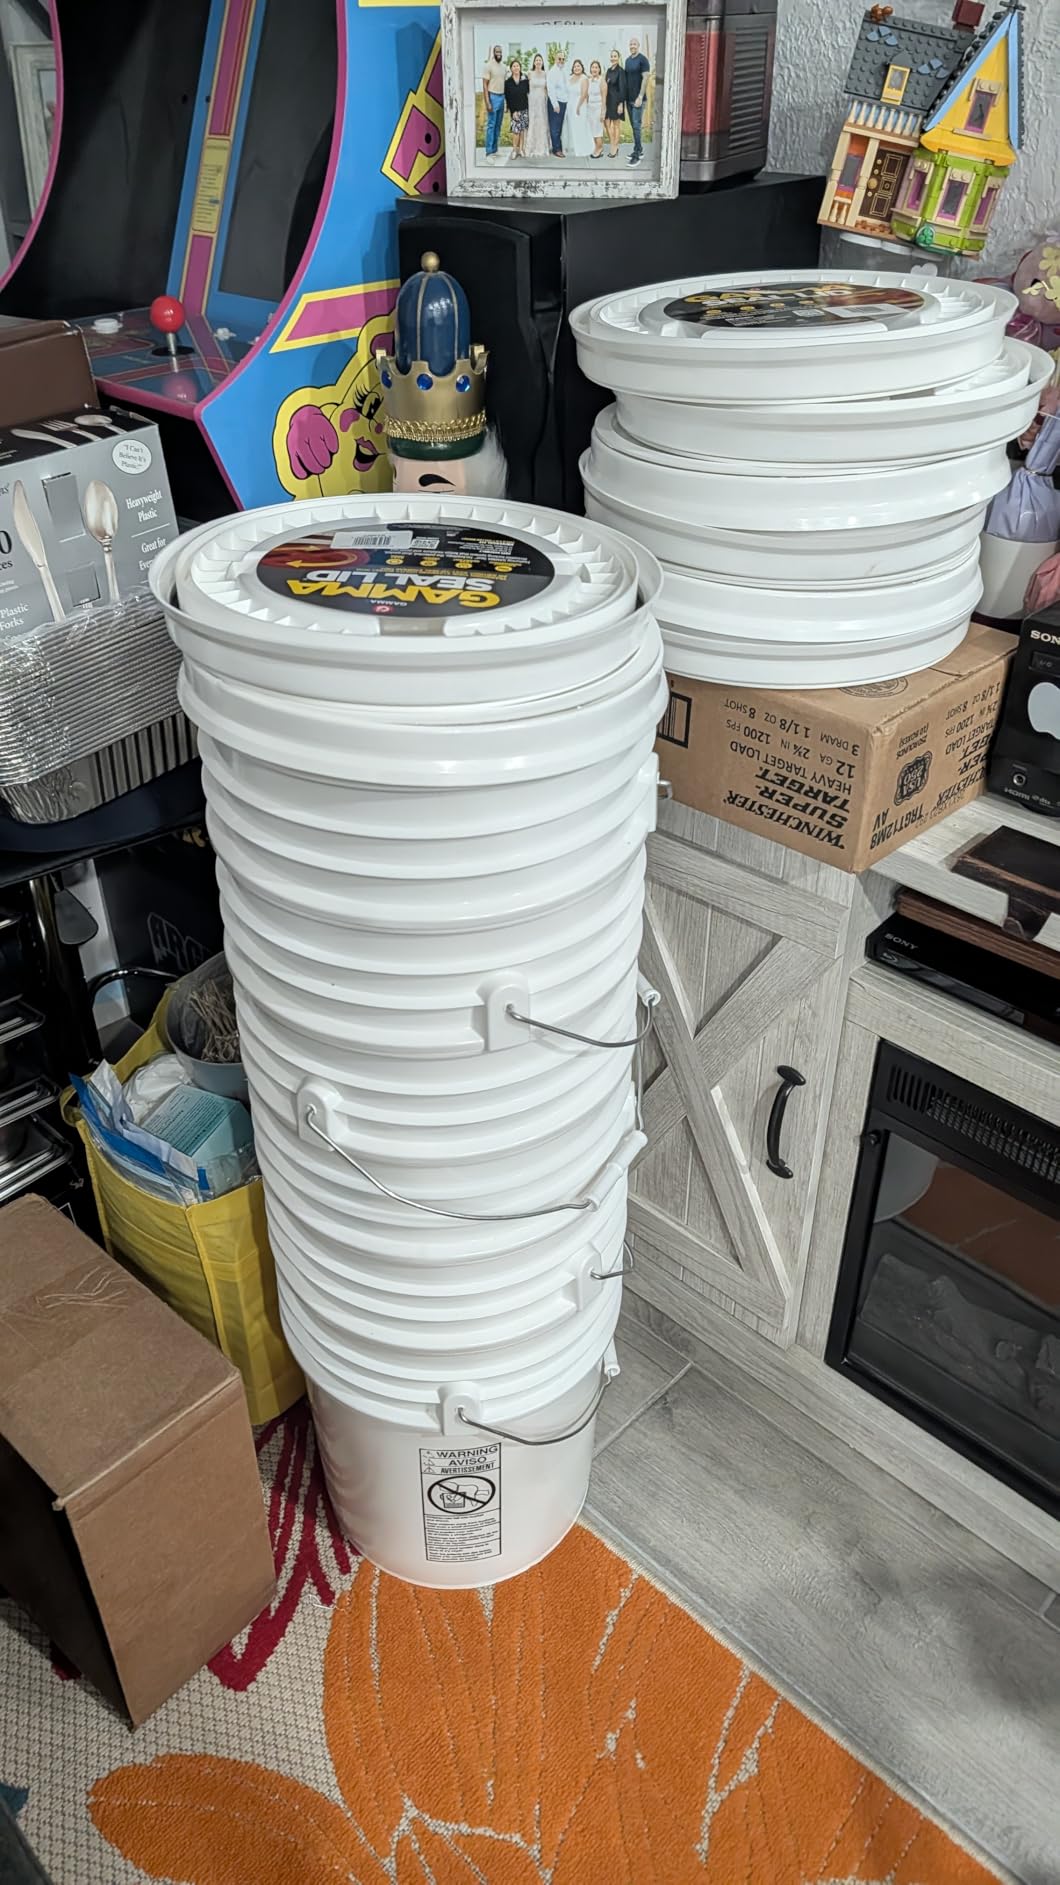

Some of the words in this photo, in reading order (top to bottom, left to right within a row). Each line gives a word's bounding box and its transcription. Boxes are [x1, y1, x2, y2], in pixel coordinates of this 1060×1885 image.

[125, 488, 162, 510] Heavyweight
[138, 508, 158, 522] Plastic
[141, 541, 157, 553] Great
[305, 570, 376, 586] LID
[384, 570, 495, 592] SEAL
[286, 579, 501, 608] GAMMA
[0, 603, 29, 618] Plastic
[369, 599, 408, 607] GAMMA
[0, 617, 24, 631] Forks
[1030, 630, 1060, 646] SON
[724, 698, 748, 714] SHOT
[748, 708, 756, 719] 8
[946, 706, 962, 720] SHOT
[962, 700, 968, 713] 8
[726, 719, 741, 732] FPS
[764, 712, 776, 724] OZ
[956, 714, 974, 733] 1200
[744, 726, 772, 745] 1200
[944, 726, 956, 738] FPS
[780, 738, 790, 750] IN
[820, 732, 849, 750] DRAM
[945, 738, 966, 756] LOAD
[730, 740, 760, 761] LOAD
[852, 744, 860, 756] 3
[762, 754, 808, 780] TARGET
[819, 752, 833, 766] GA
[836, 760, 856, 779] 12
[903, 766, 923, 782] 250
[810, 771, 852, 796] HEAVY
[936, 767, 986, 808] CHESTER
[756, 784, 848, 829] SUPER-
[726, 790, 844, 850] WINCHESTER
[872, 808, 890, 832] AV
[884, 933, 918, 950] SONY
[436, 1445, 498, 1458] WARNING
[441, 1462, 495, 1474] AVERTISSEMENT
[448, 1456, 488, 1466] AVISO
